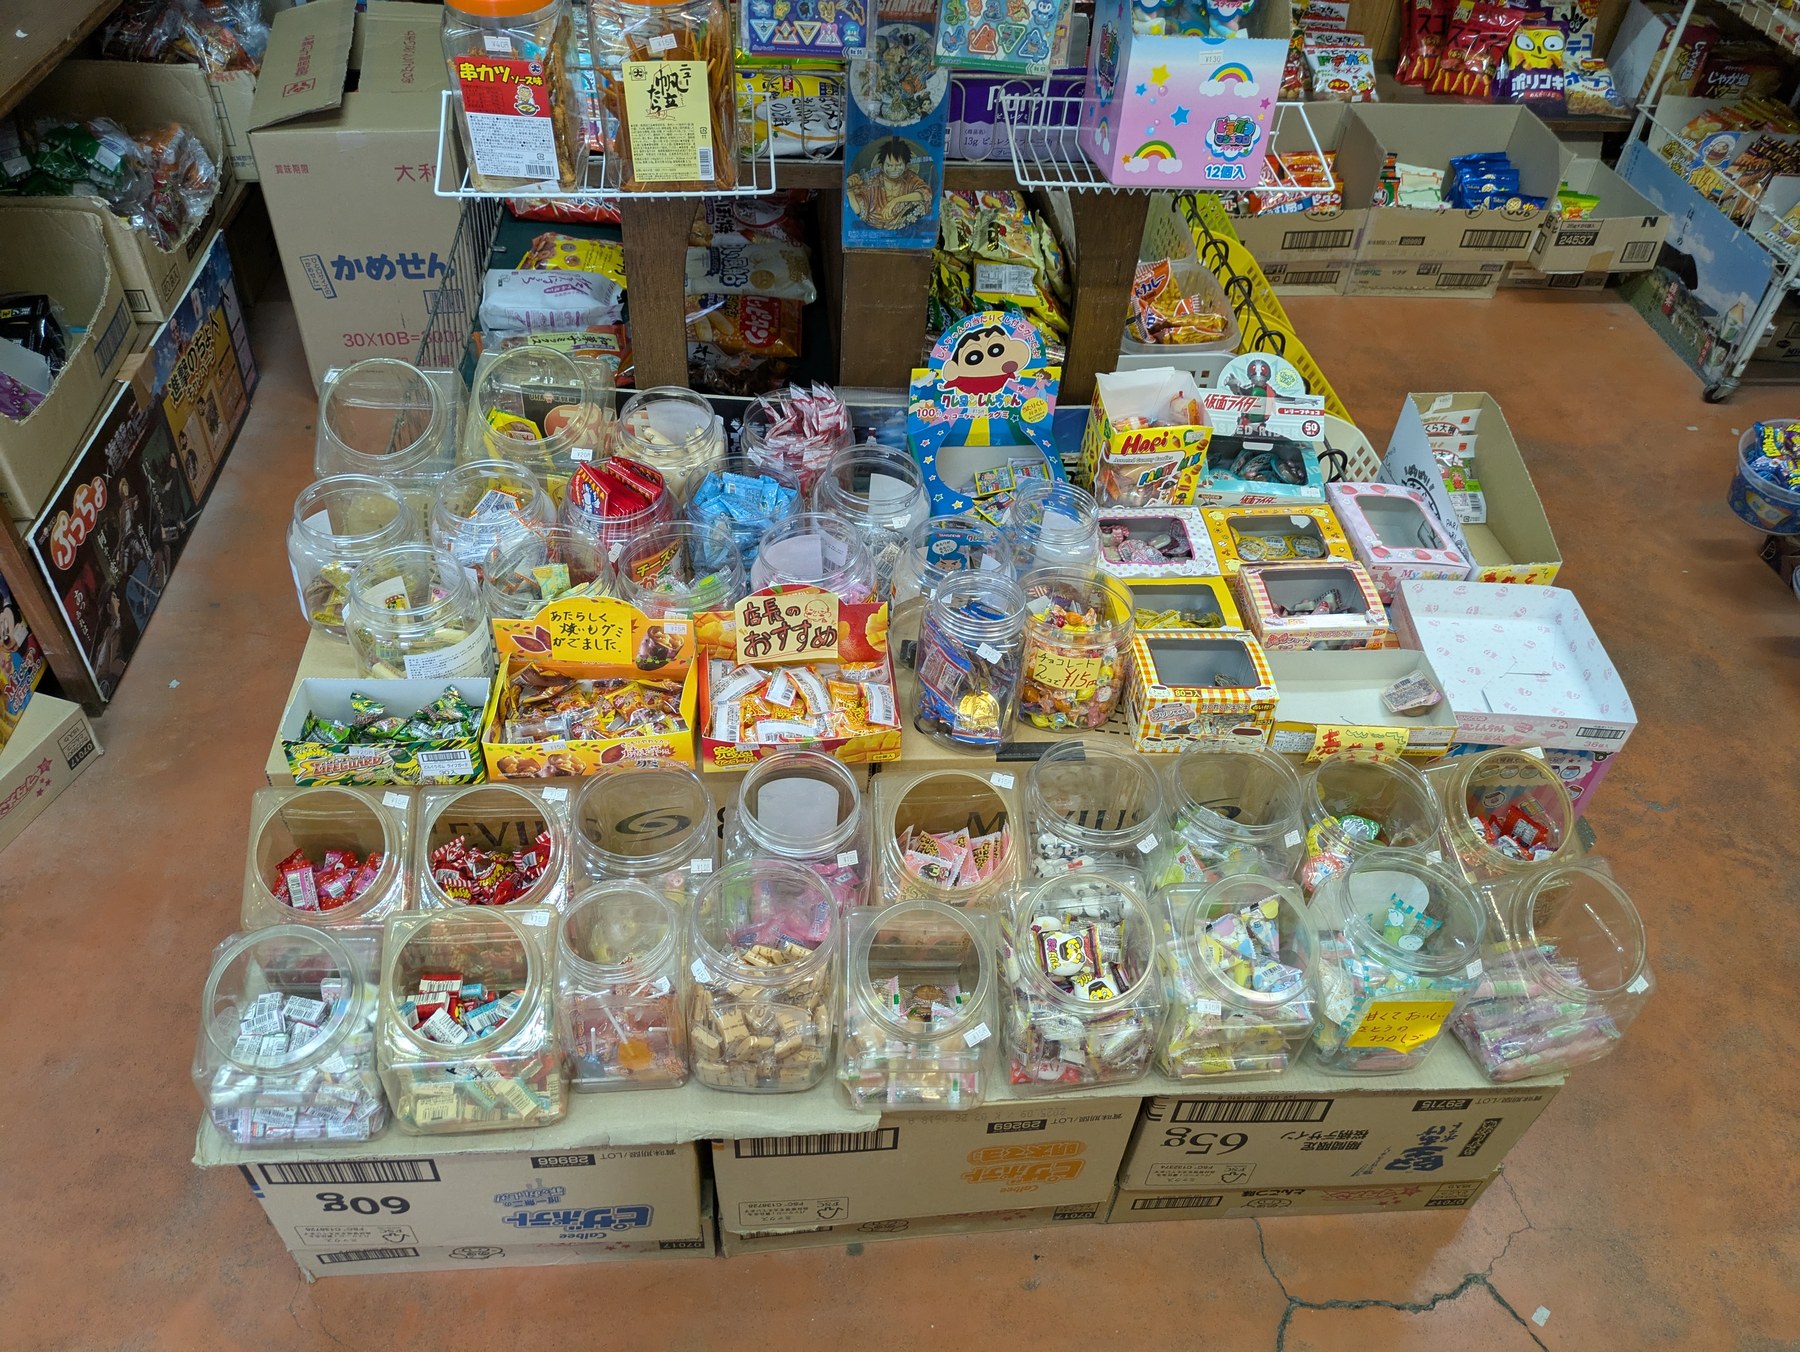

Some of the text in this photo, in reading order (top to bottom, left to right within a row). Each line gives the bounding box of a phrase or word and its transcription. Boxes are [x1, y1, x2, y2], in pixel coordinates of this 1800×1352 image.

[459, 62, 511, 83] 串カツ
[680, 64, 692, 93] ニュー
[511, 75, 544, 86] ソース味
[646, 85, 664, 112] たら
[963, 137, 978, 146] 13g
[1205, 165, 1245, 179] 12個入
[1558, 236, 1593, 245] 24537
[331, 252, 456, 281] かめせん
[941, 393, 1022, 408] クレヨンしんちゃん
[1204, 394, 1263, 413] 仮面ライダー
[1305, 424, 1318, 432] 50
[51, 476, 108, 570] ぷっちょ
[1401, 570, 1419, 580] My
[551, 611, 608, 622] あたらしく
[742, 598, 800, 627] 店長の
[743, 620, 837, 657] おすすめ
[1037, 653, 1095, 668] チョコレート
[313, 756, 384, 774] LIFEGUARD
[1421, 1100, 1465, 1108] 29715
[993, 1121, 1041, 1130] 29269
[1159, 1126, 1249, 1156] 65g
[1279, 1129, 1369, 1141] 桜柄デザイン
[1300, 1141, 1362, 1151] 期間限定
[537, 1156, 589, 1165] 28966
[960, 1159, 1085, 1185] ピザポテト
[1000, 1184, 1039, 1193] Calbee
[1241, 1188, 1306, 1197] とんこつ味
[316, 1192, 411, 1215] 60g
[502, 1204, 654, 1231] ピザポテト
[559, 1232, 607, 1240] Calbee
